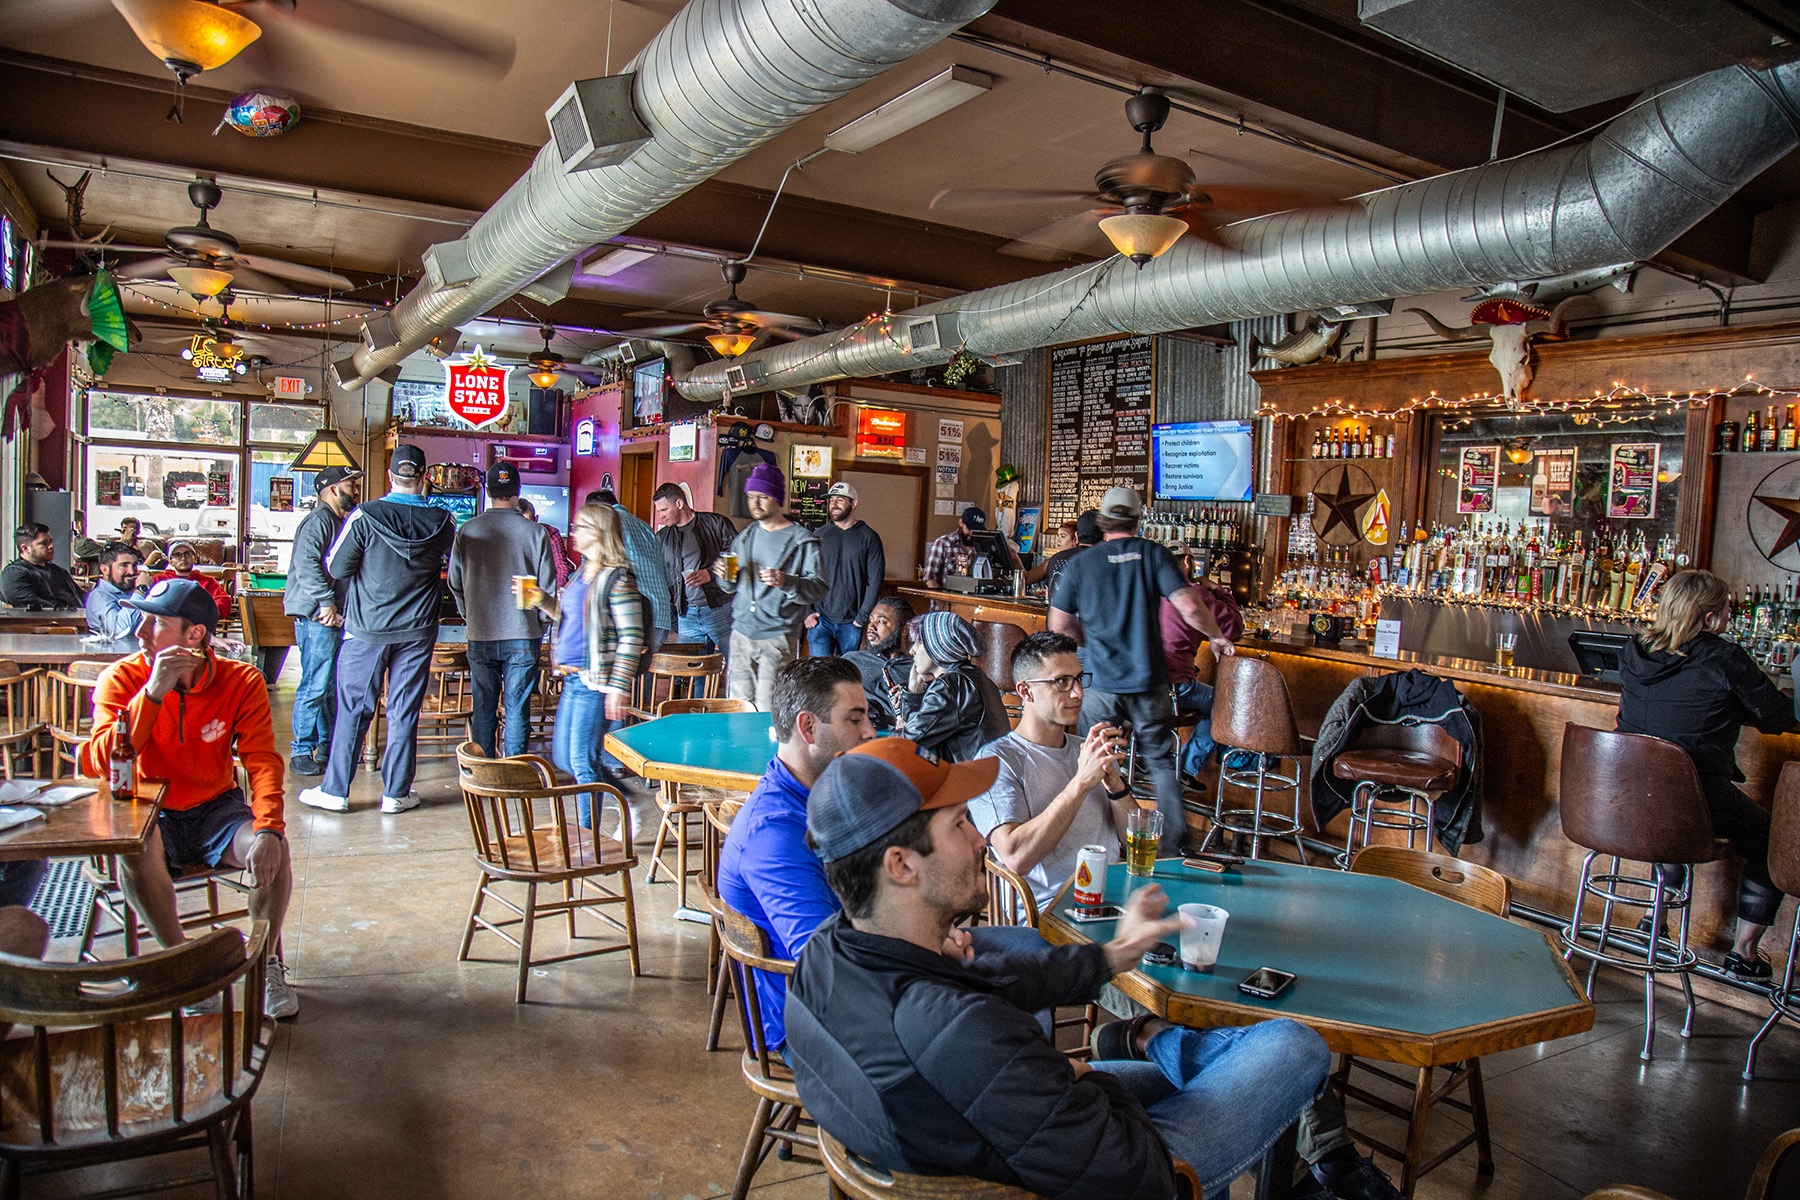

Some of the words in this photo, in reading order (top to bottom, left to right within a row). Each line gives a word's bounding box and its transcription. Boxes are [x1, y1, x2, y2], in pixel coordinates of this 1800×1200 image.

[280, 378, 300, 393] EXIT
[455, 374, 499, 390] LONE
[454, 390, 500, 405] STAR
[870, 418, 901, 426] Budweiser
[940, 426, 961, 438] 51%
[939, 451, 959, 463] 51%
[1550, 461, 1572, 472] TITO'S
[1550, 472, 1570, 482] MULE
[791, 479, 807, 493] NEW
